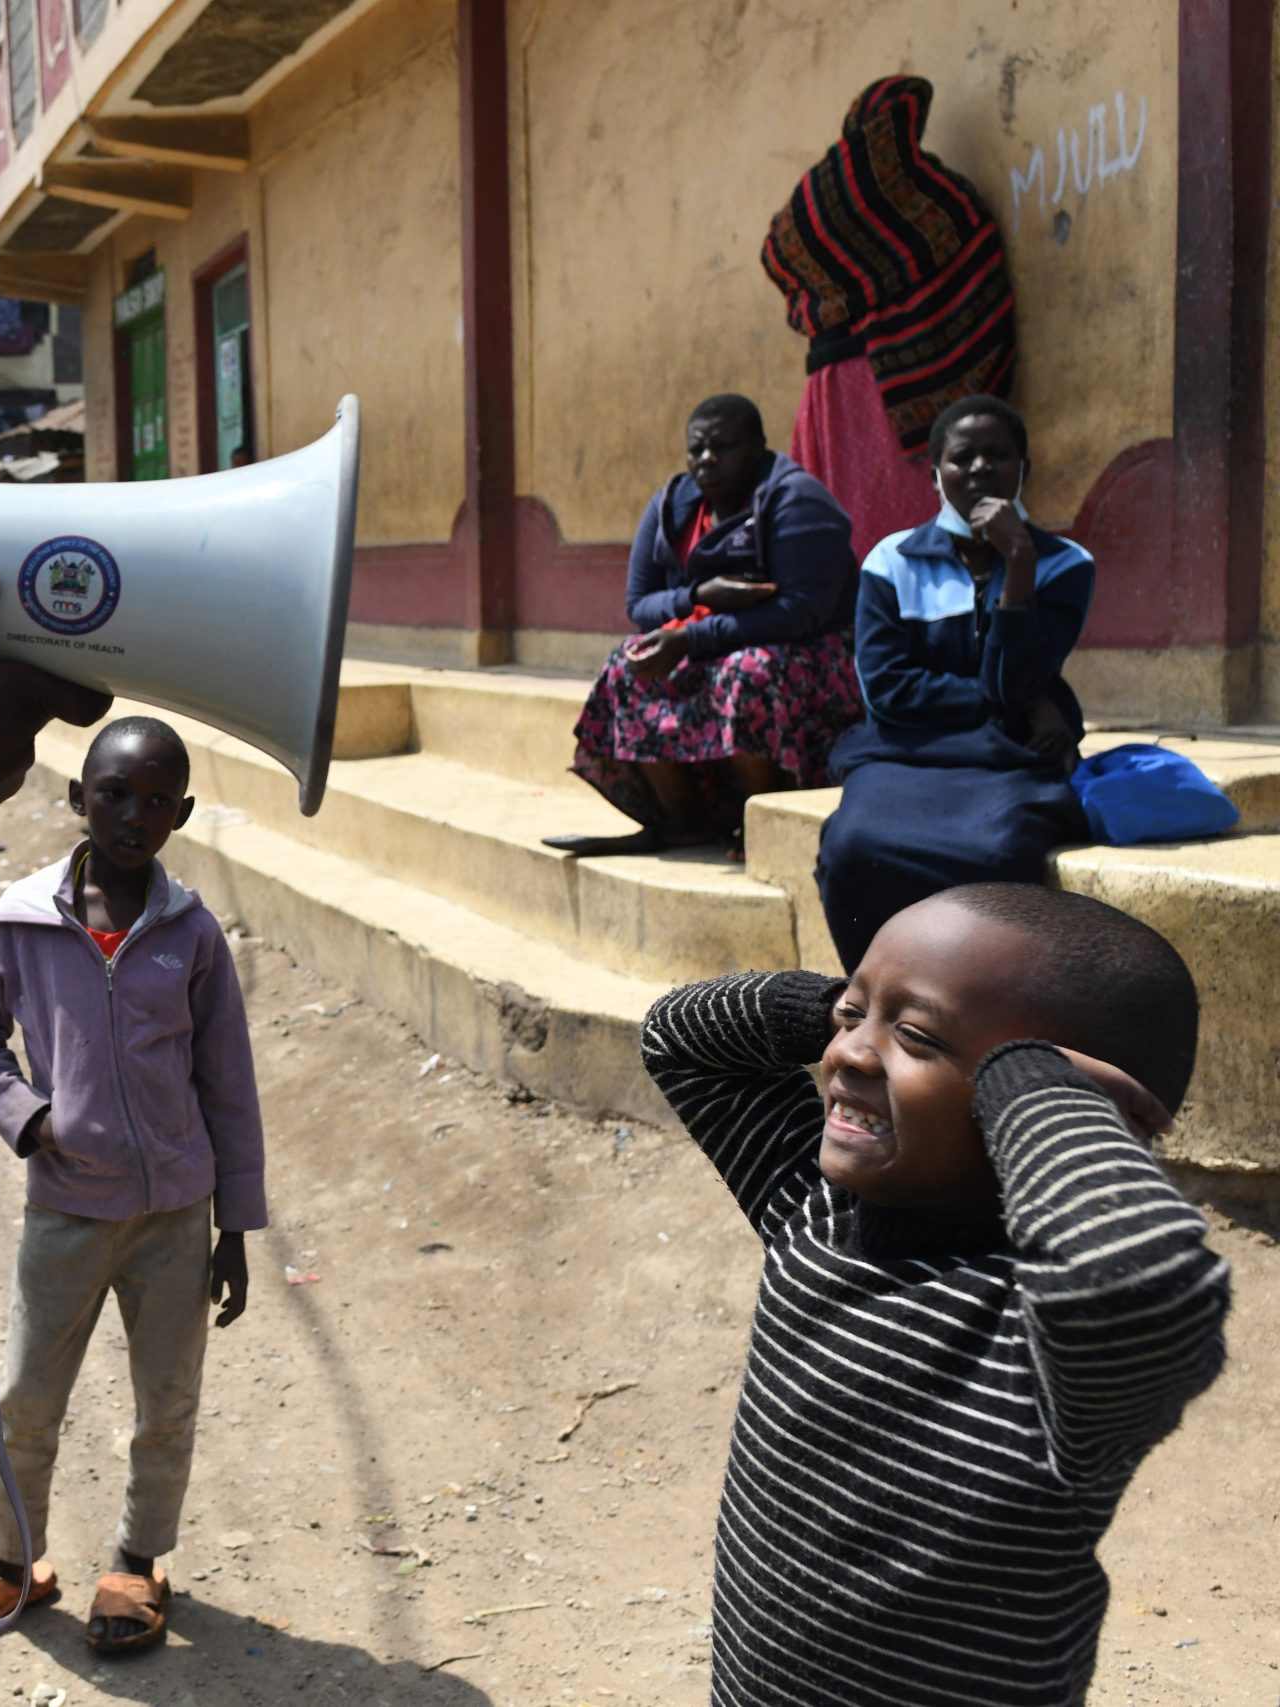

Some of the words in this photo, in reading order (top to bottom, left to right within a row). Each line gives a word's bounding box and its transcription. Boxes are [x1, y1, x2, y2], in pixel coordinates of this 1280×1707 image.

[6, 632, 71, 648] DIRECTORATE
[73, 641, 87, 650] OF
[88, 643, 125, 655] HEALTH
